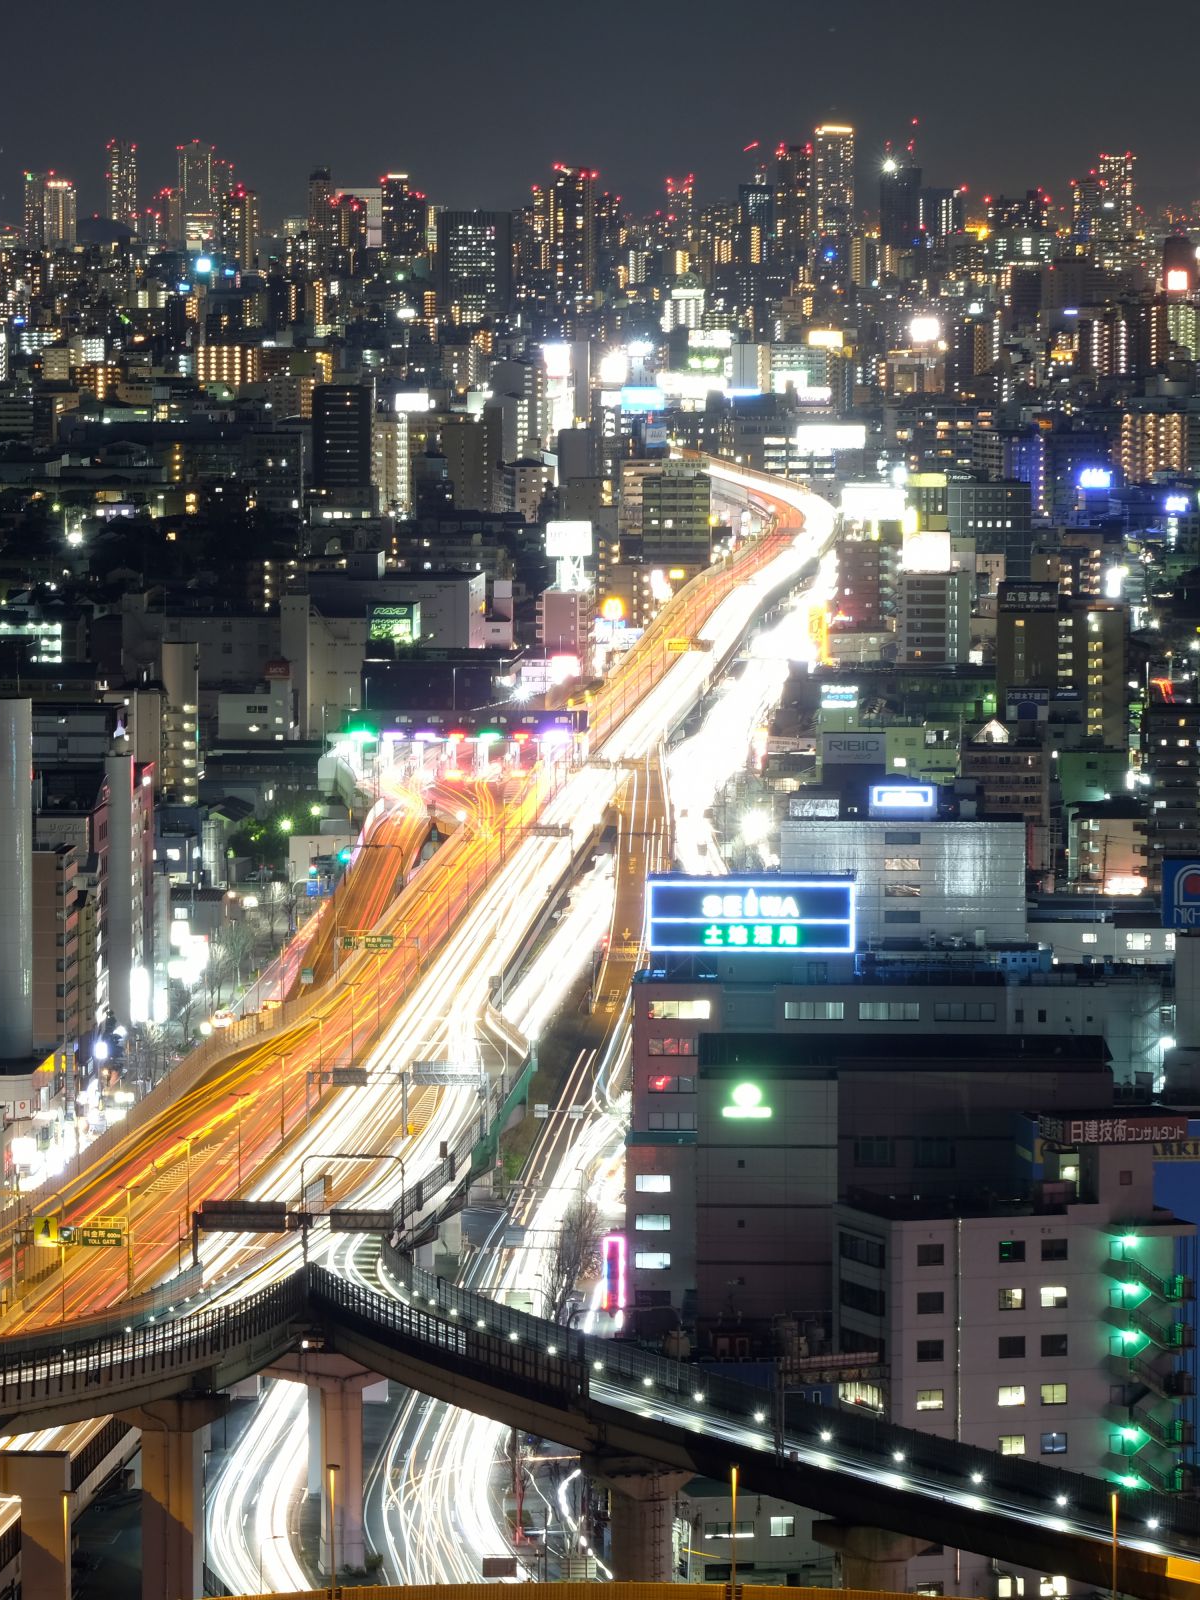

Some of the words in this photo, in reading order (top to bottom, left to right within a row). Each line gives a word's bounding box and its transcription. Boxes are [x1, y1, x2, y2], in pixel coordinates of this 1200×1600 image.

[373, 607, 408, 615] RAYS
[828, 740, 880, 752] RIBIC
[702, 887, 800, 918] SEIWA
[704, 924, 799, 946] 土地活用
[1070, 1118, 1185, 1143] 日建技術コンサルタント
